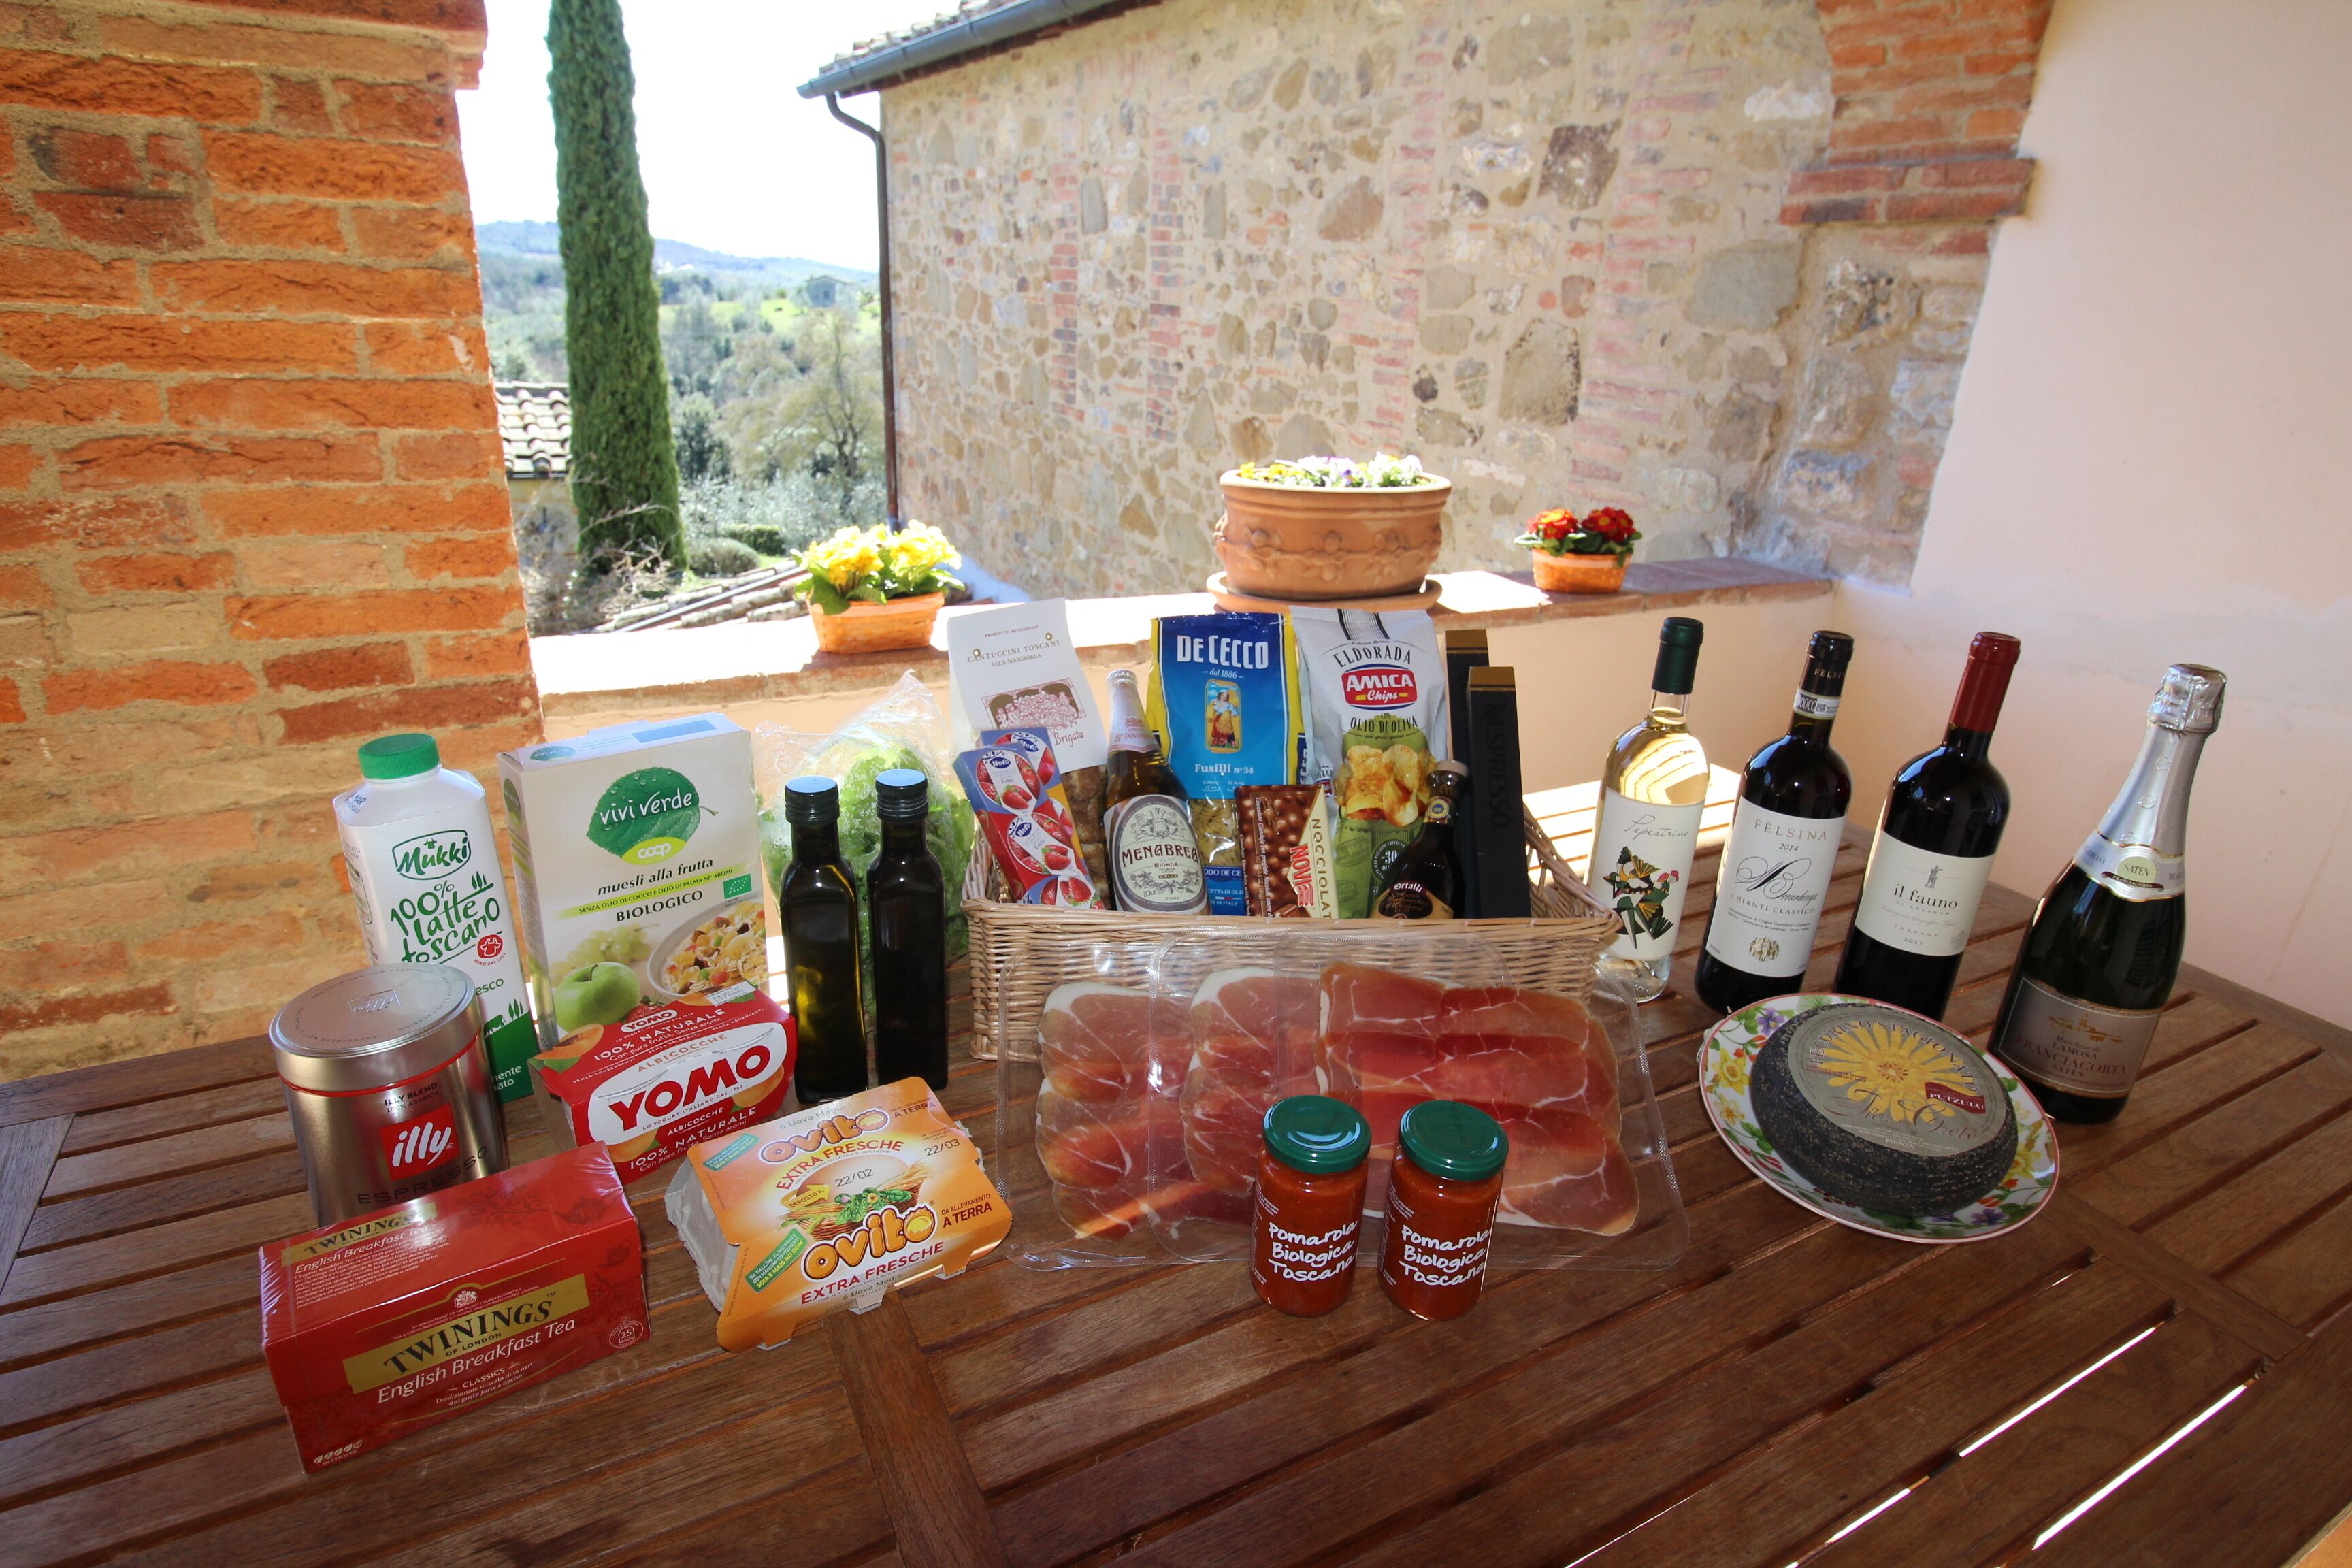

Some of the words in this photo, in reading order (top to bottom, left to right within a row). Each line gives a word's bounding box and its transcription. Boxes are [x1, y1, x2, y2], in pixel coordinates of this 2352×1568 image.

[967, 648, 1020, 663] CANTUCCINI
[1024, 640, 1060, 653] TOSCANI
[1008, 653, 1041, 664] MANDORLA
[1209, 636, 1268, 669] CECCO
[1333, 645, 1411, 668] ELDORADA
[1210, 668, 1220, 676] dal
[1221, 670, 1237, 679] 1886
[1347, 674, 1414, 692] AMICA
[1367, 690, 1397, 703] Chips
[1350, 717, 1374, 732] OLIO
[1392, 716, 1418, 732] OLIVA
[1054, 731, 1083, 747] Brigata
[992, 758, 1009, 767] Hero
[1195, 764, 1230, 773] Fusilli
[1482, 702, 1510, 830] NESPRESSO
[600, 800, 636, 826] vivi
[639, 788, 693, 817] verde
[1017, 822, 1032, 836] Hero
[1754, 819, 1827, 840] FÈLSINA
[397, 836, 468, 875] Mukki
[637, 843, 671, 860] coop
[1122, 844, 1199, 867] MENABREA
[1778, 843, 1799, 852] 2014
[598, 874, 644, 896] muesli
[649, 869, 672, 883] alla
[677, 859, 713, 875] frutta
[1289, 843, 1313, 886] NOVI
[2123, 864, 2151, 877] SATÈN
[578, 904, 600, 913] SENZA
[628, 893, 652, 902] COCCO
[683, 878, 702, 887] PALMA
[714, 869, 733, 878] AROMI
[1731, 893, 1769, 911] CHIANTI
[1893, 884, 1906, 898] il
[1909, 889, 1957, 909] fauno
[391, 881, 454, 936] 100%
[616, 890, 703, 922] BIOLOGICO
[1903, 937, 1923, 945] 2011
[594, 1041, 635, 1061] 100%
[640, 1008, 726, 1041] NATURALE
[626, 1011, 672, 1030] YOMO
[573, 1075, 593, 1083] SENZA
[649, 1044, 667, 1054] SENZA
[713, 1023, 730, 1031] SENZA
[610, 1052, 629, 1061] Con
[630, 1043, 648, 1055] pura
[674, 1024, 698, 1036] Senza
[700, 1017, 721, 1028] aromi
[637, 1034, 728, 1073] ALBICOCCHE
[1809, 1020, 1872, 1064] PECORINO
[1876, 1020, 1979, 1092] STAGIONATO
[384, 1094, 404, 1106] ILLY
[408, 1083, 438, 1100] BLEND
[408, 1090, 439, 1107] ARABICA
[608, 1045, 771, 1132] YOMO
[653, 1112, 680, 1125] YOGURT
[682, 1097, 714, 1113] ITALIANO
[668, 1107, 723, 1137] ALBICOCCHE
[902, 1102, 936, 1115] TERRA
[391, 1122, 452, 1168] illy
[630, 1147, 668, 1169] 100%
[675, 1107, 757, 1148] NATURALE
[640, 1158, 657, 1171] Con
[659, 1152, 675, 1164] pura
[703, 1130, 724, 1141] Senza
[725, 1120, 747, 1131] aromi
[760, 1109, 888, 1162] ovito
[924, 1139, 960, 1157] 22/03
[357, 1146, 487, 1205] ESPRESSO
[775, 1157, 823, 1190] EXTRA
[823, 1139, 904, 1158] FRESCHE
[834, 1168, 874, 1188] 22/02
[789, 1192, 817, 1208] DEPOSTO
[950, 1193, 990, 1213] ALLEVAMENTO
[943, 1216, 952, 1228] A
[952, 1201, 992, 1224] TERRA
[804, 1205, 936, 1279] ovito
[1268, 1221, 1358, 1246] Pomarola
[1402, 1224, 1491, 1252] Pomarola
[295, 1254, 340, 1274] English
[344, 1232, 405, 1258] Breakfast
[408, 1226, 429, 1237] Tea
[752, 1275, 763, 1284] CON
[760, 1260, 778, 1277] MANGIMI
[777, 1236, 800, 1262] CONTENENTI
[755, 1258, 773, 1275] GALLINE
[772, 1232, 796, 1258] ALIMENTATE
[1272, 1240, 1355, 1267] Biologica
[1403, 1244, 1487, 1273] Biologica
[756, 1275, 770, 1288] SOIA
[772, 1261, 786, 1273] MAIS
[785, 1253, 793, 1261] NO
[791, 1241, 804, 1254] OGM
[801, 1275, 860, 1305] EXTRA
[865, 1241, 945, 1280] FRESCHE
[1268, 1252, 1355, 1281] Toscana
[1399, 1260, 1486, 1287] Toscana
[851, 1286, 873, 1296] Uova
[876, 1274, 903, 1287] Medie
[383, 1301, 553, 1375] TWININGS
[445, 1348, 458, 1357] OF
[462, 1332, 502, 1352] LONDON
[621, 1329, 632, 1339] 25
[378, 1367, 446, 1404] English
[452, 1332, 542, 1375] Breakfast
[544, 1318, 576, 1339] Tea
[436, 1387, 478, 1403] Tradizionale
[479, 1377, 504, 1389] miscela
[520, 1362, 533, 1372] neri
[448, 1398, 460, 1406] dal
[461, 1392, 480, 1402] gusto
[480, 1386, 496, 1396] forte
[503, 1374, 523, 1386] deciso
[461, 1367, 506, 1388] CLASSICS
